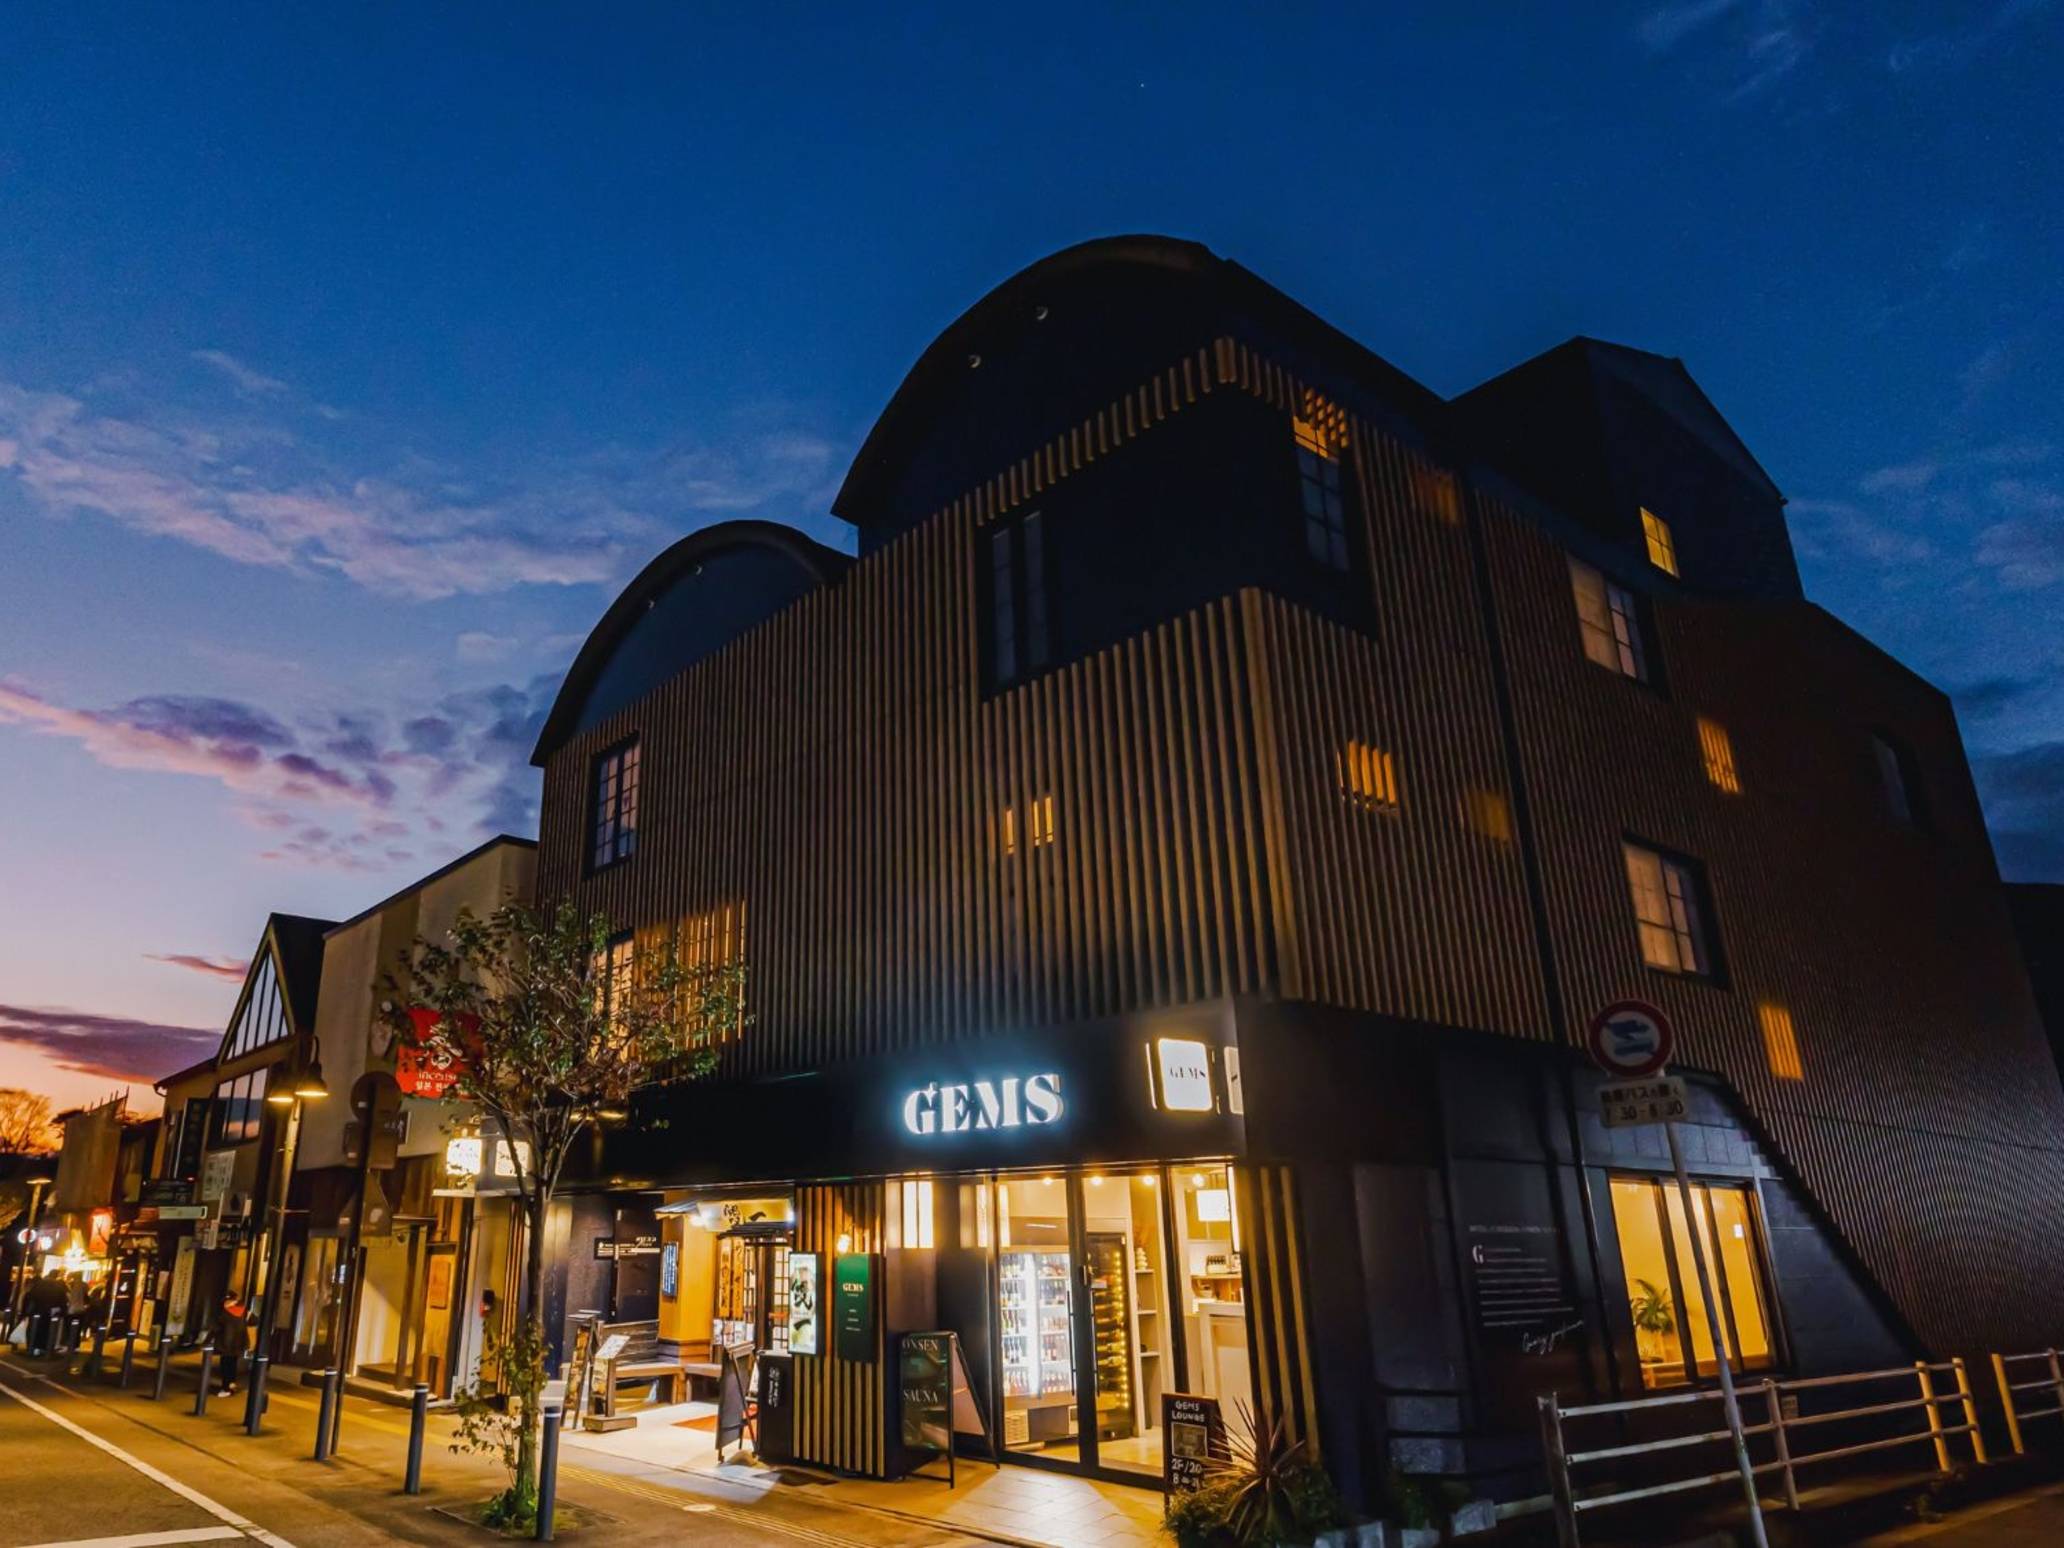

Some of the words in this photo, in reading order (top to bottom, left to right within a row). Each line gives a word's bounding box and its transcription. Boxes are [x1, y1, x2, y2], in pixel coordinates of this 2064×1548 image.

[1169, 1066, 1206, 1080] GEMS
[903, 1073, 1062, 1135] GEMS
[903, 1388, 938, 1403] SAUNA
[1175, 1401, 1200, 1411] GEMS
